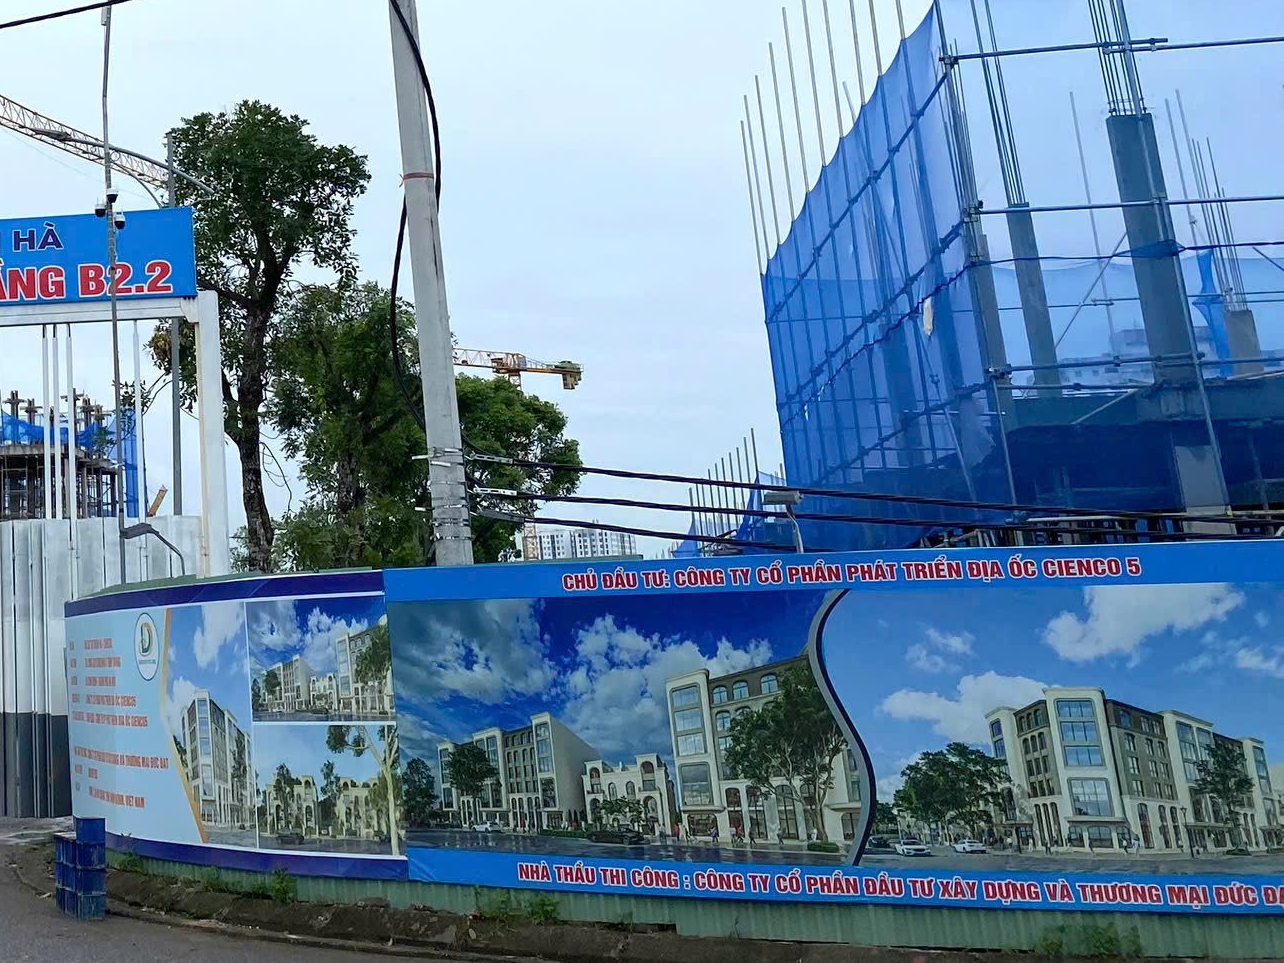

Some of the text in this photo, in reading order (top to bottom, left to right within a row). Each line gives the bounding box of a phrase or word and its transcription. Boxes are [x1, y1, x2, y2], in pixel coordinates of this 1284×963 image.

[12, 221, 64, 252] HÀ
[78, 260, 174, 298] B2.2
[562, 554, 1142, 590] CHỦ ĐẦU TƯ: CÔNG TY CỔ PHẦN PHÁT TRIỂN ĐỊA ỐC CIENCO 5
[517, 862, 550, 882] NHÀ
[554, 861, 596, 884] THẦU
[599, 868, 627, 886] THI
[630, 866, 679, 889] CÔNG
[693, 869, 746, 892] CÔNG
[748, 873, 771, 894] TY
[775, 868, 802, 894] CỔ
[806, 871, 860, 895] PHẦN
[863, 871, 904, 897] ĐẦU
[908, 878, 936, 898] TƯ
[939, 875, 979, 900] XÂY
[982, 879, 1041, 905] DỰNG
[1043, 879, 1074, 903] VÀ
[1077, 882, 1164, 905] THƯƠNG
[1167, 885, 1211, 909] MẠI
[1215, 882, 1258, 906] ĐỨC
